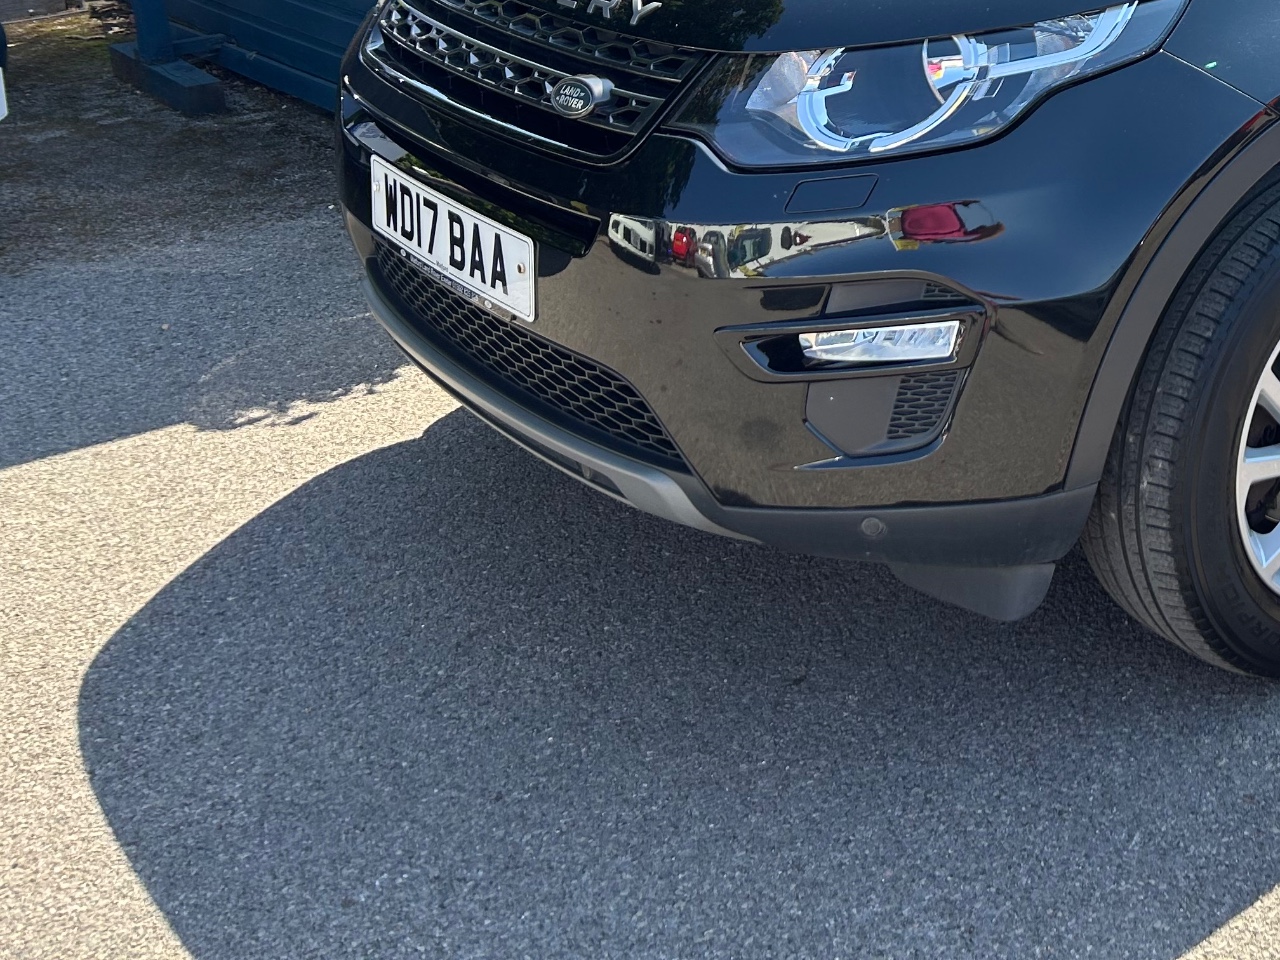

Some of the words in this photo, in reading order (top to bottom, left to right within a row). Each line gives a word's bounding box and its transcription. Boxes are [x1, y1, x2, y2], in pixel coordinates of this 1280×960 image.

[560, 84, 581, 97] LAND
[558, 94, 584, 109] ROVER
[384, 173, 438, 255] WD17
[448, 209, 508, 296] BAA
